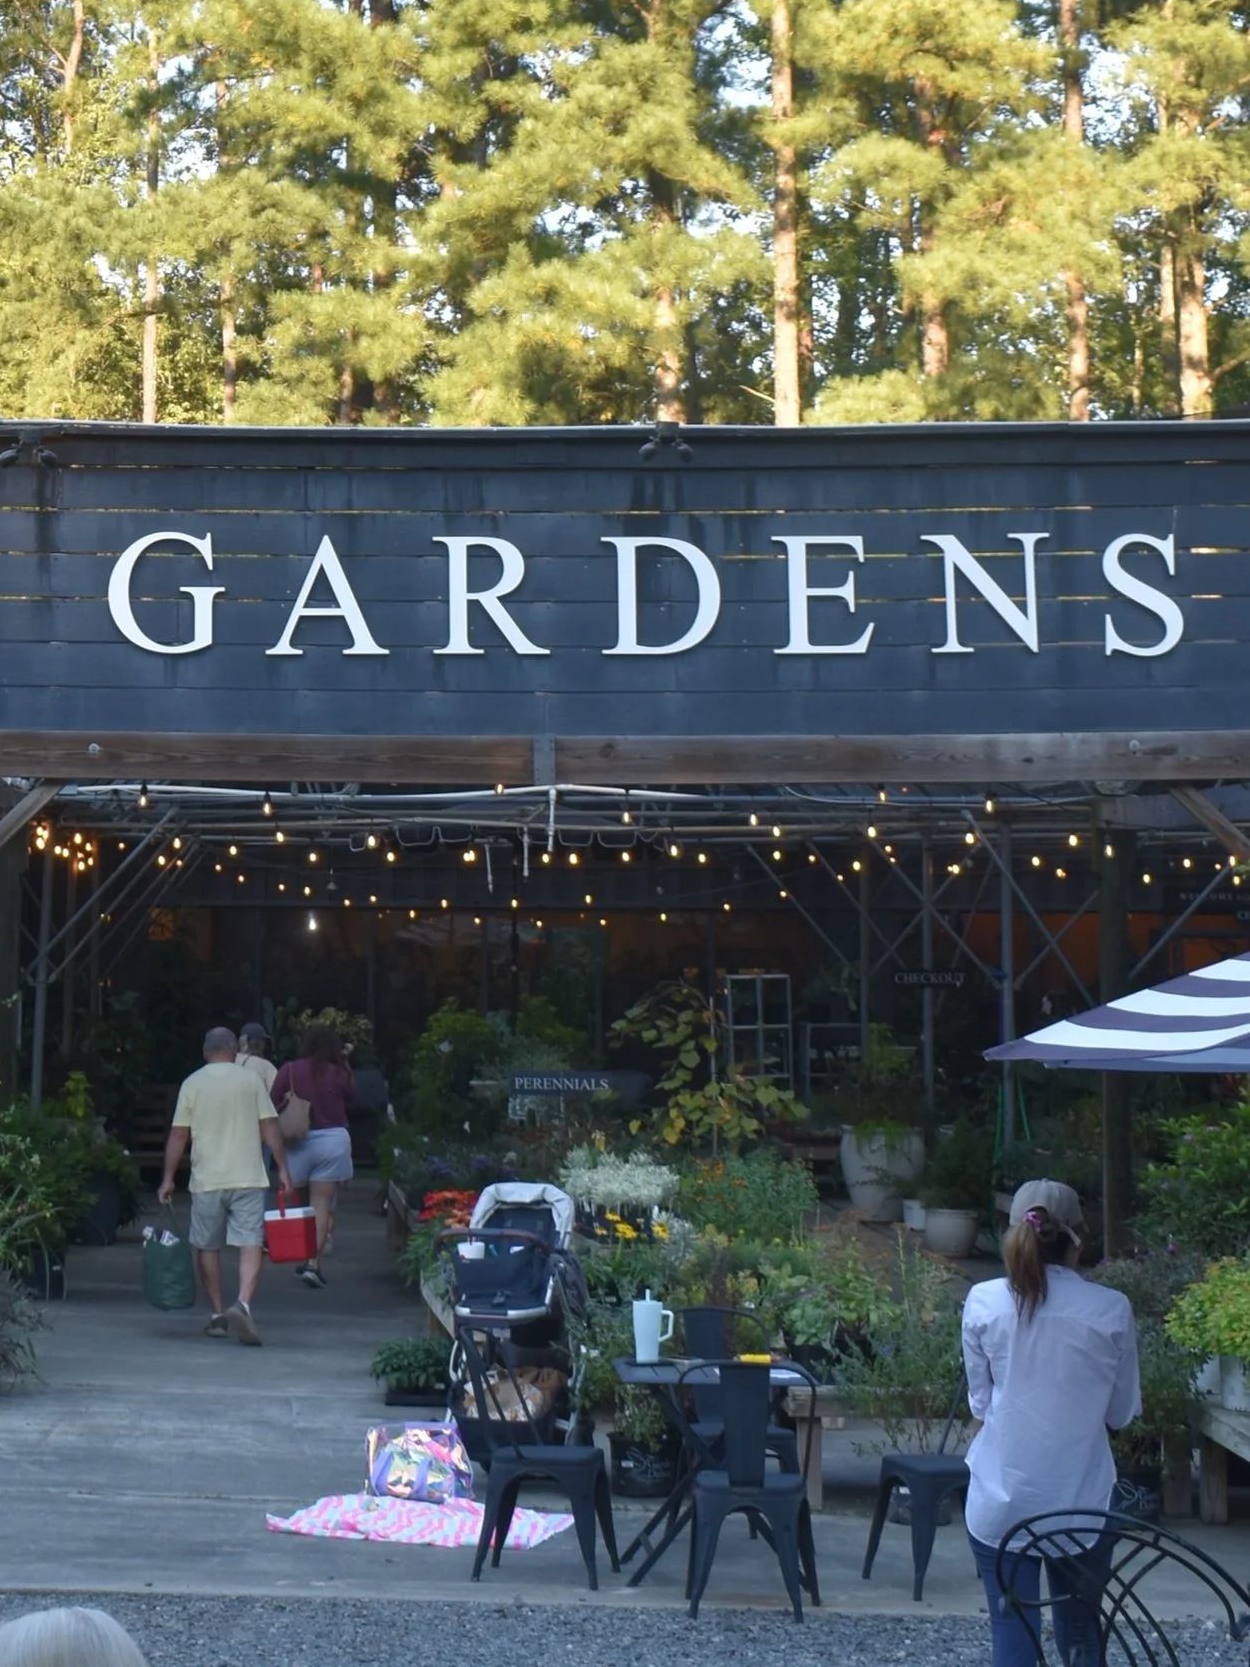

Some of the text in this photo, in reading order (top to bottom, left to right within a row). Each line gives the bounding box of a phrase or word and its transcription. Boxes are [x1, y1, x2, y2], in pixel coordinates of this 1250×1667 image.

[106, 531, 1185, 656] GARDENS
[894, 972, 966, 984] CHECKOUT
[514, 1076, 609, 1090] PERENNIALS
